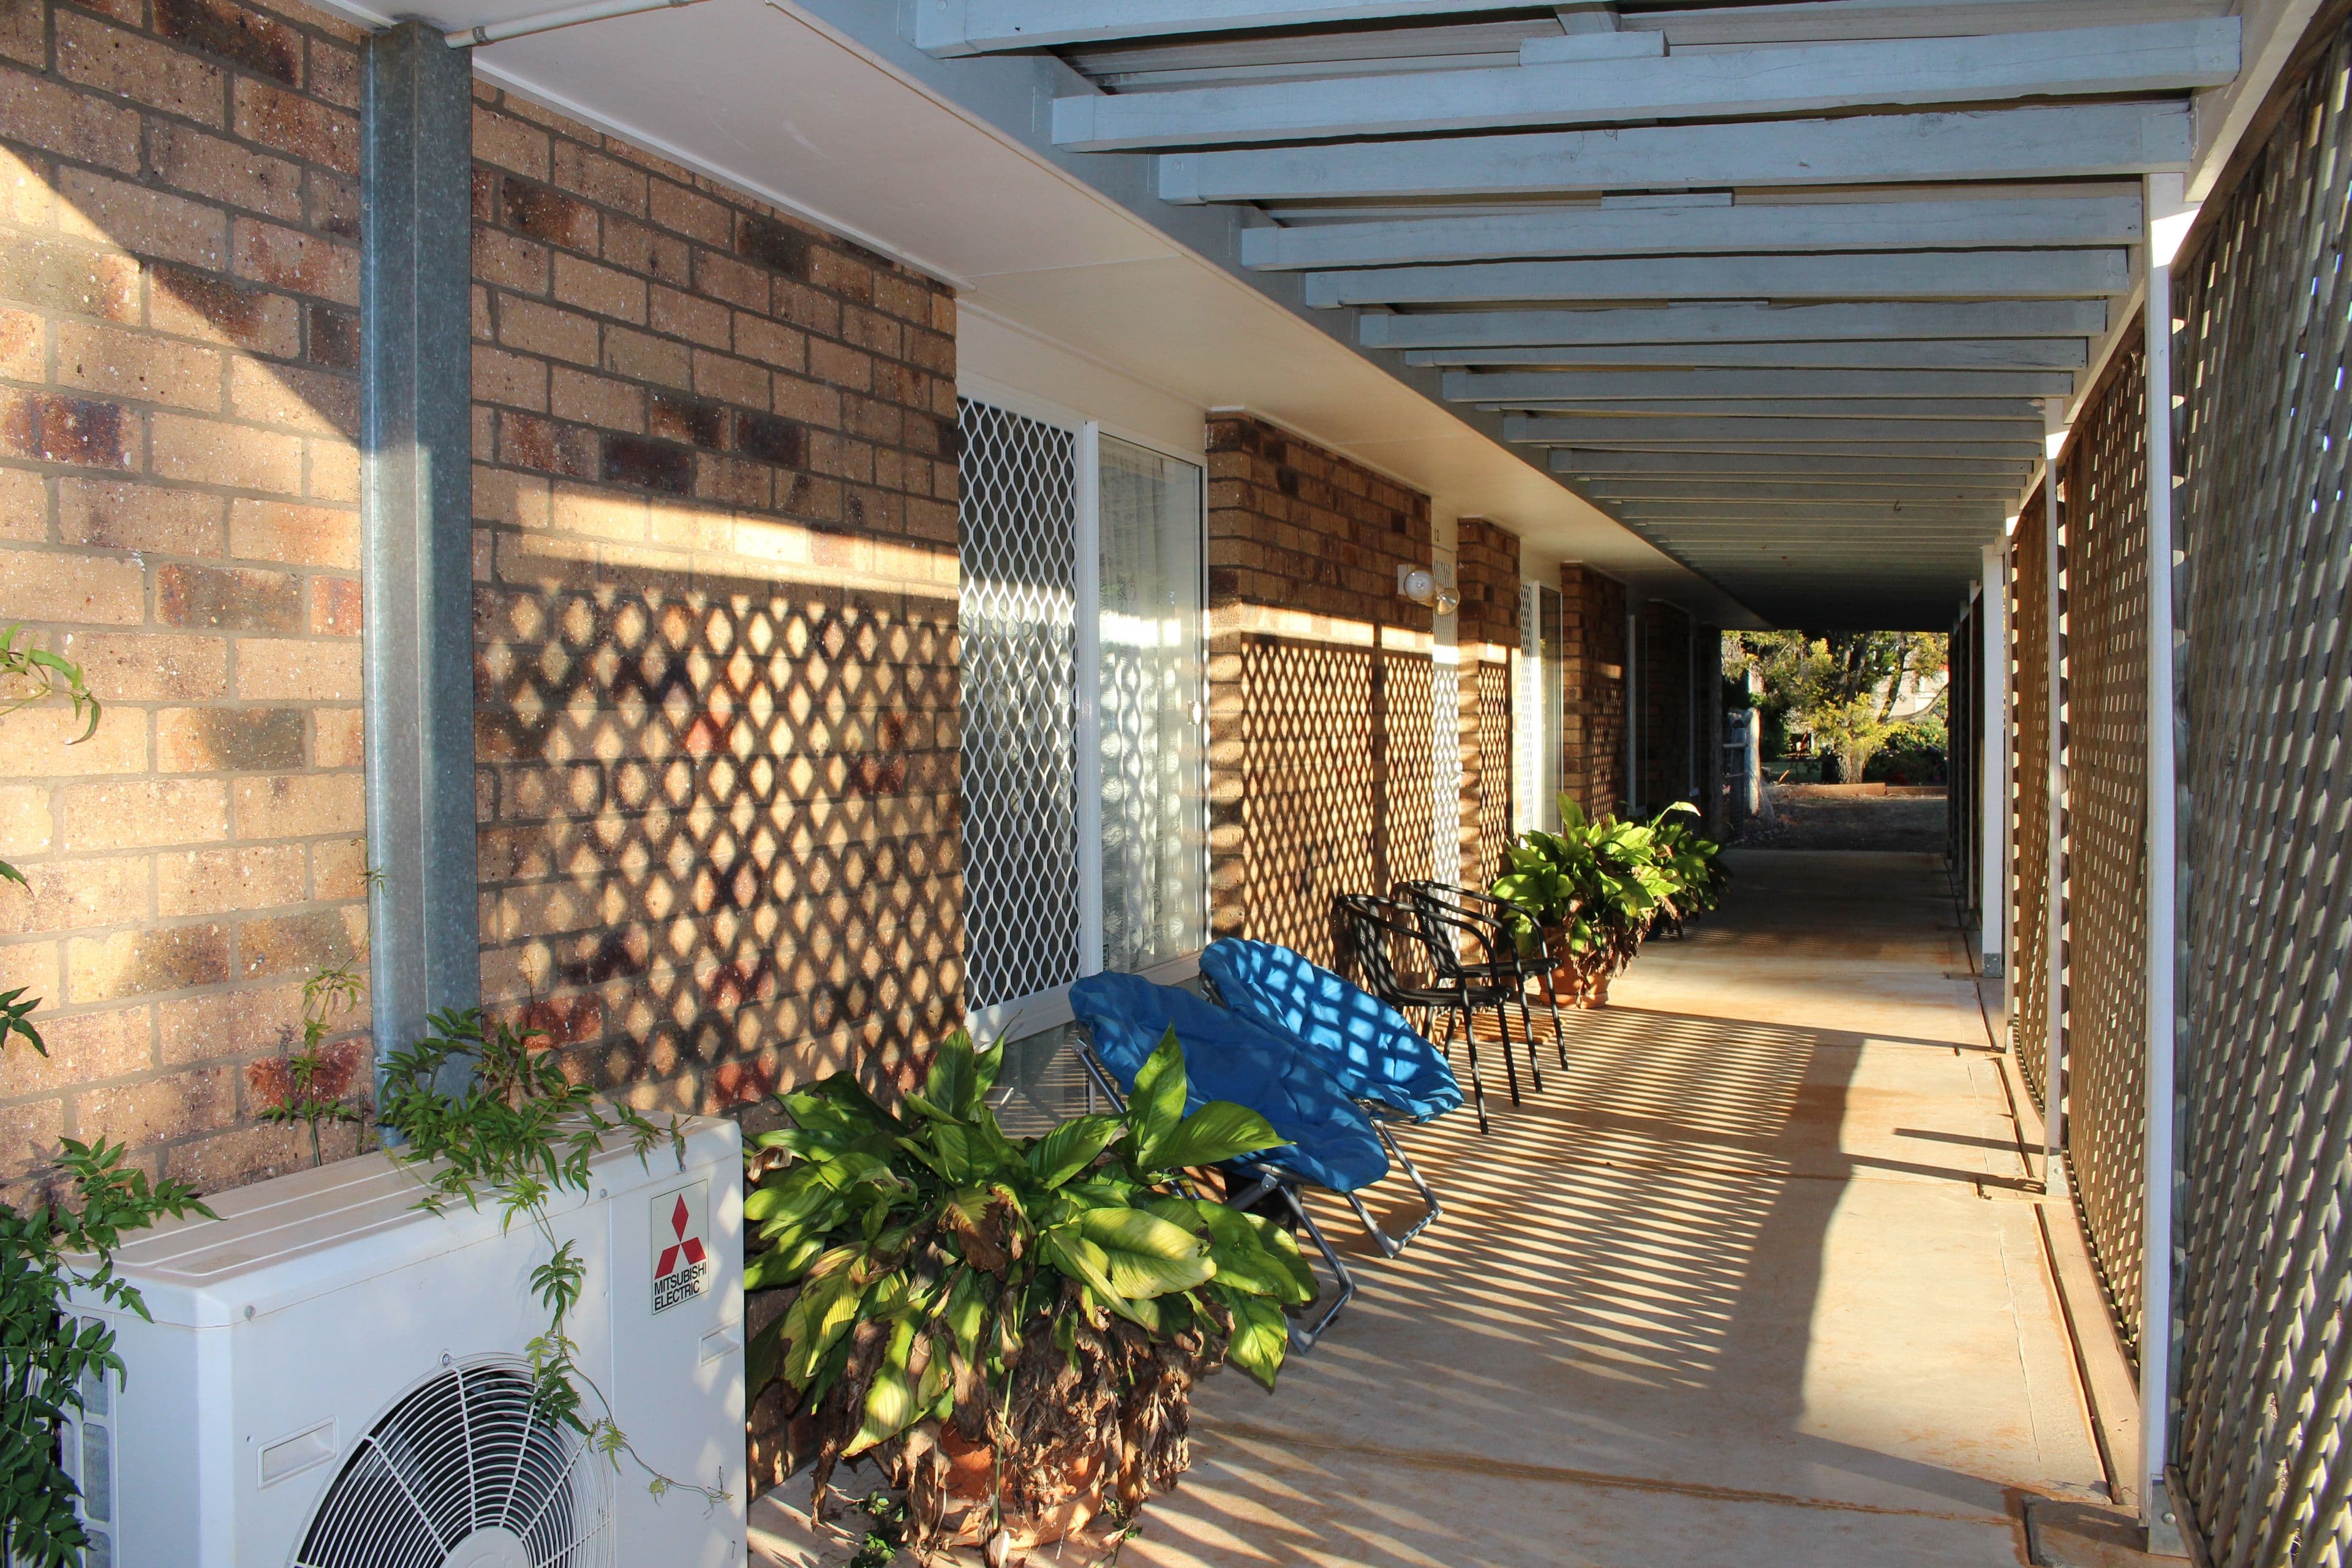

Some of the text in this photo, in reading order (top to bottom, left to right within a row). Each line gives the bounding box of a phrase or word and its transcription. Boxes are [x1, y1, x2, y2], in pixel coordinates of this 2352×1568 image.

[1434, 529, 1440, 542] 12
[654, 1261, 707, 1296] MITSUBISHI
[655, 1280, 700, 1311] ELECTRIC
